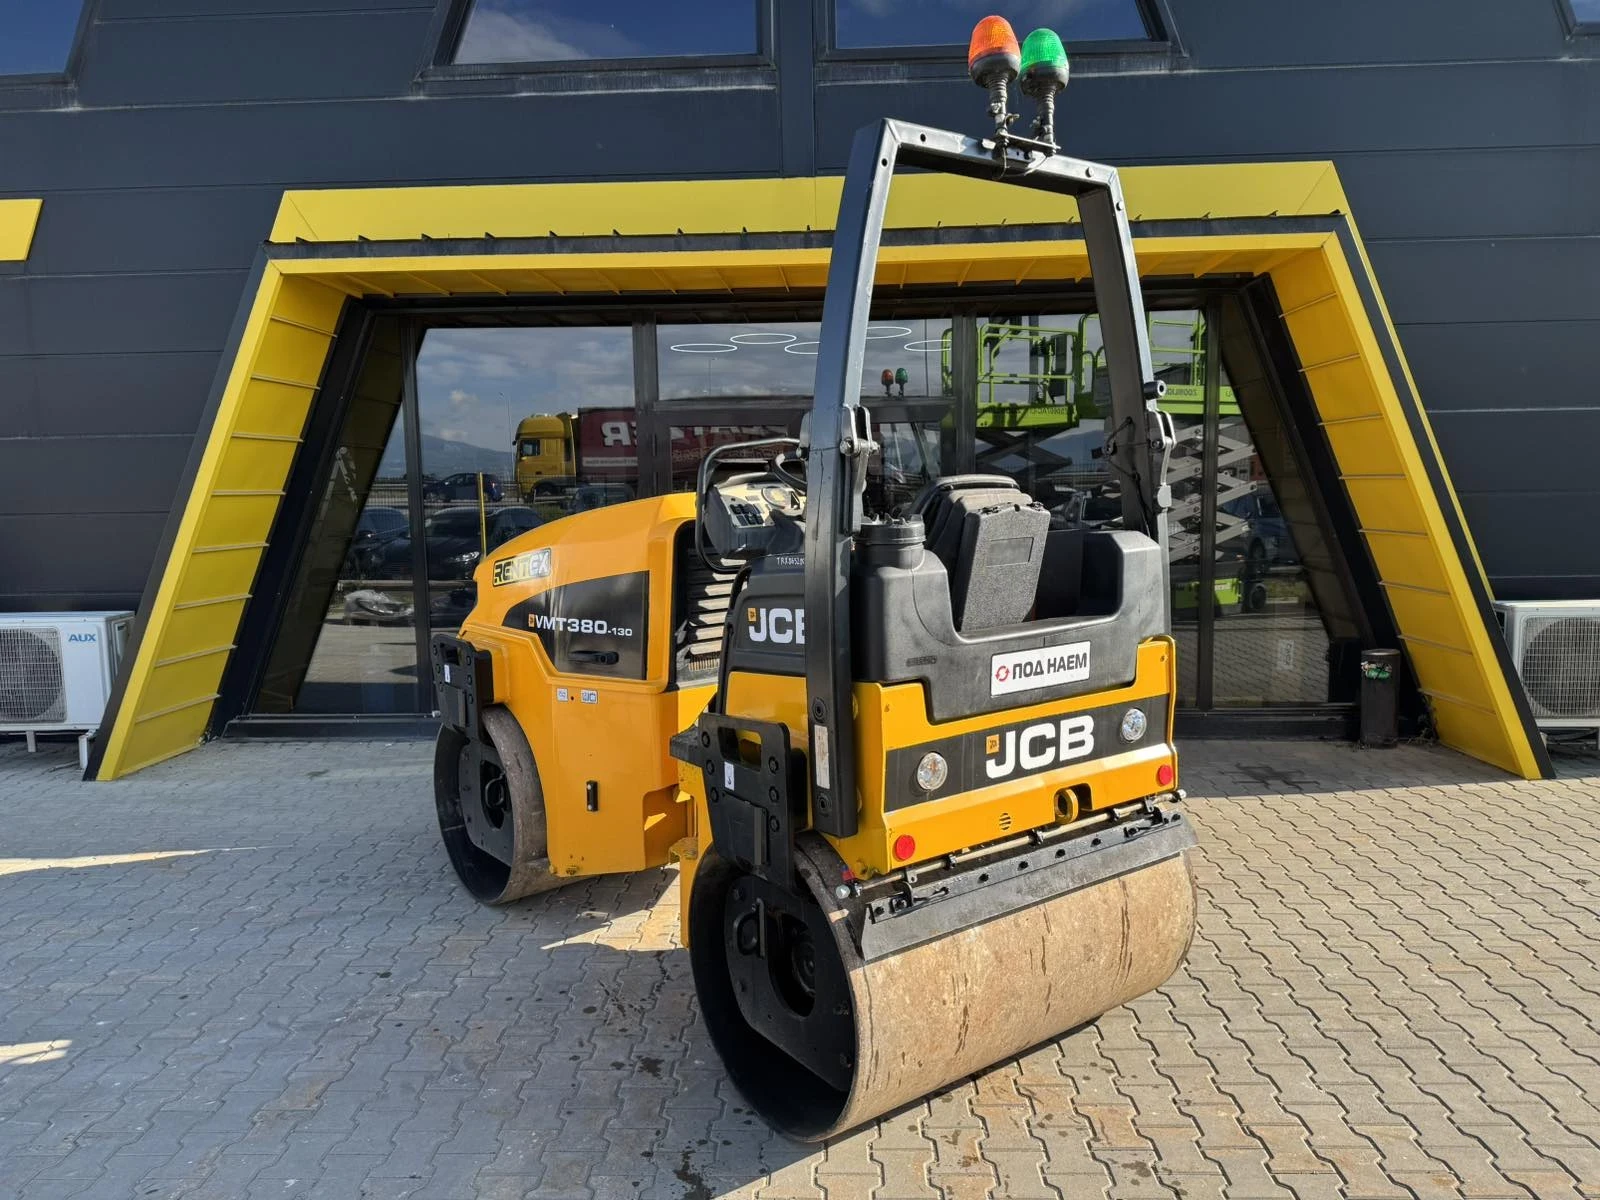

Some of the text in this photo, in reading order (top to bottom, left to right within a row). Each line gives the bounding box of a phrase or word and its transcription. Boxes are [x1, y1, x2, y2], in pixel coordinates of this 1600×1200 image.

[494, 550, 550, 584] RENTEX
[68, 633, 97, 642] AUX
[1012, 652, 1088, 680] ПОД НАЕМ
[985, 714, 1095, 779] JCB
